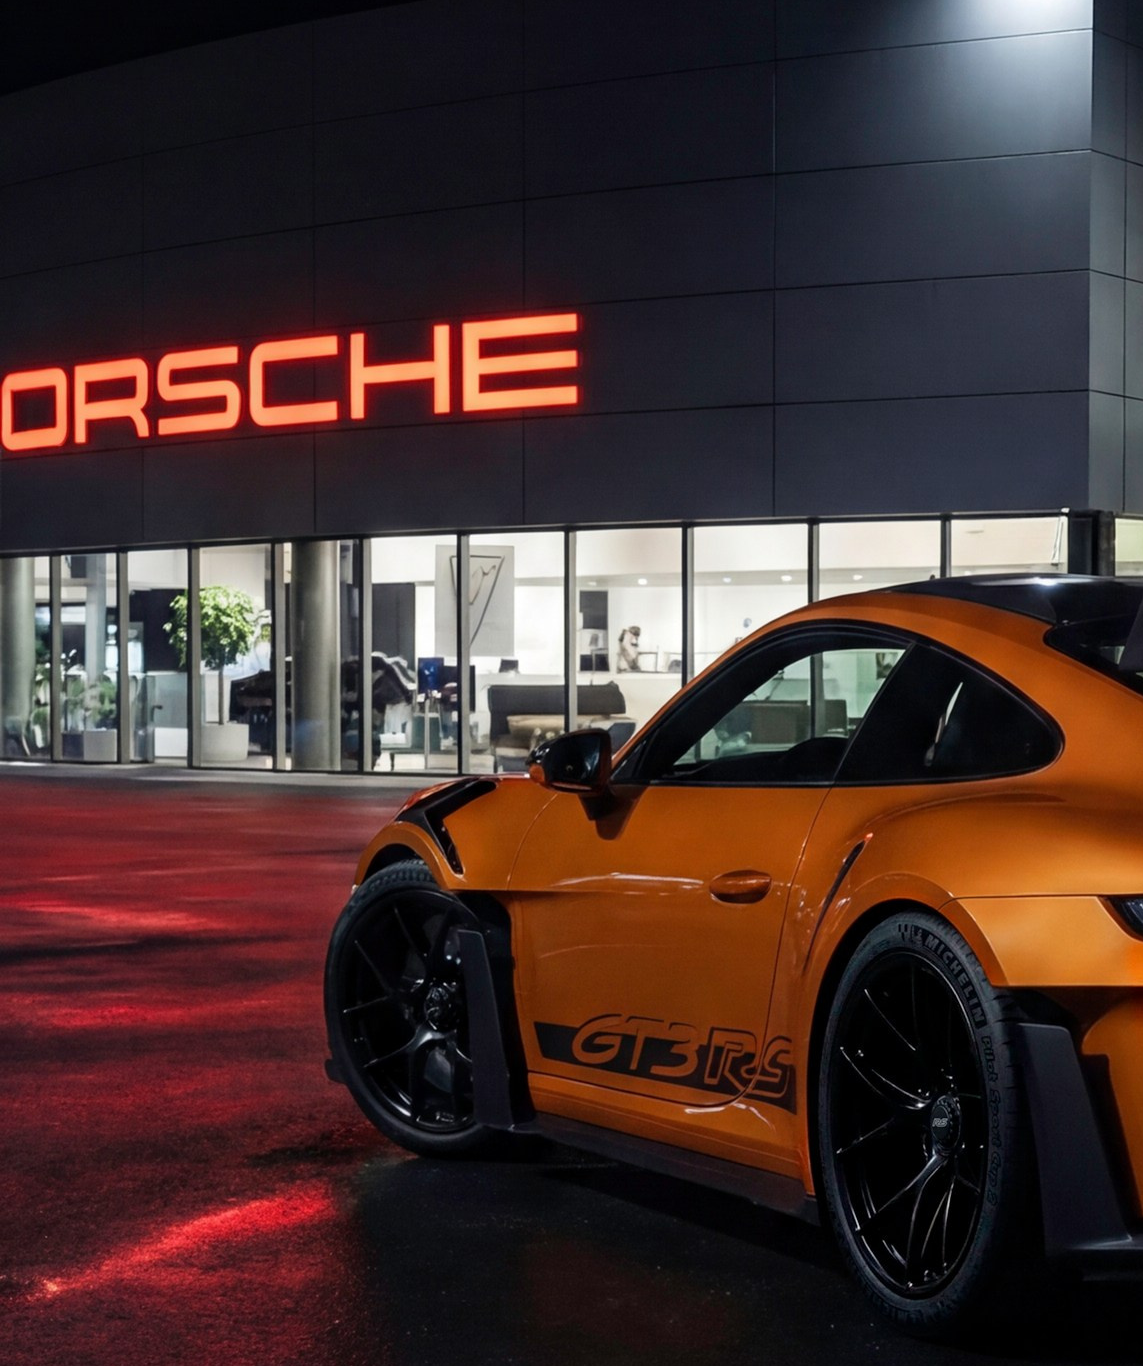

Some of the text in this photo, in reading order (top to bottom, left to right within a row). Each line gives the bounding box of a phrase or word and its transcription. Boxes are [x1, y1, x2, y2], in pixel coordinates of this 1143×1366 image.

[922, 932, 987, 1026] MICHELIN
[980, 1035, 998, 1082] Pilot
[988, 1089, 1001, 1147] Sport
